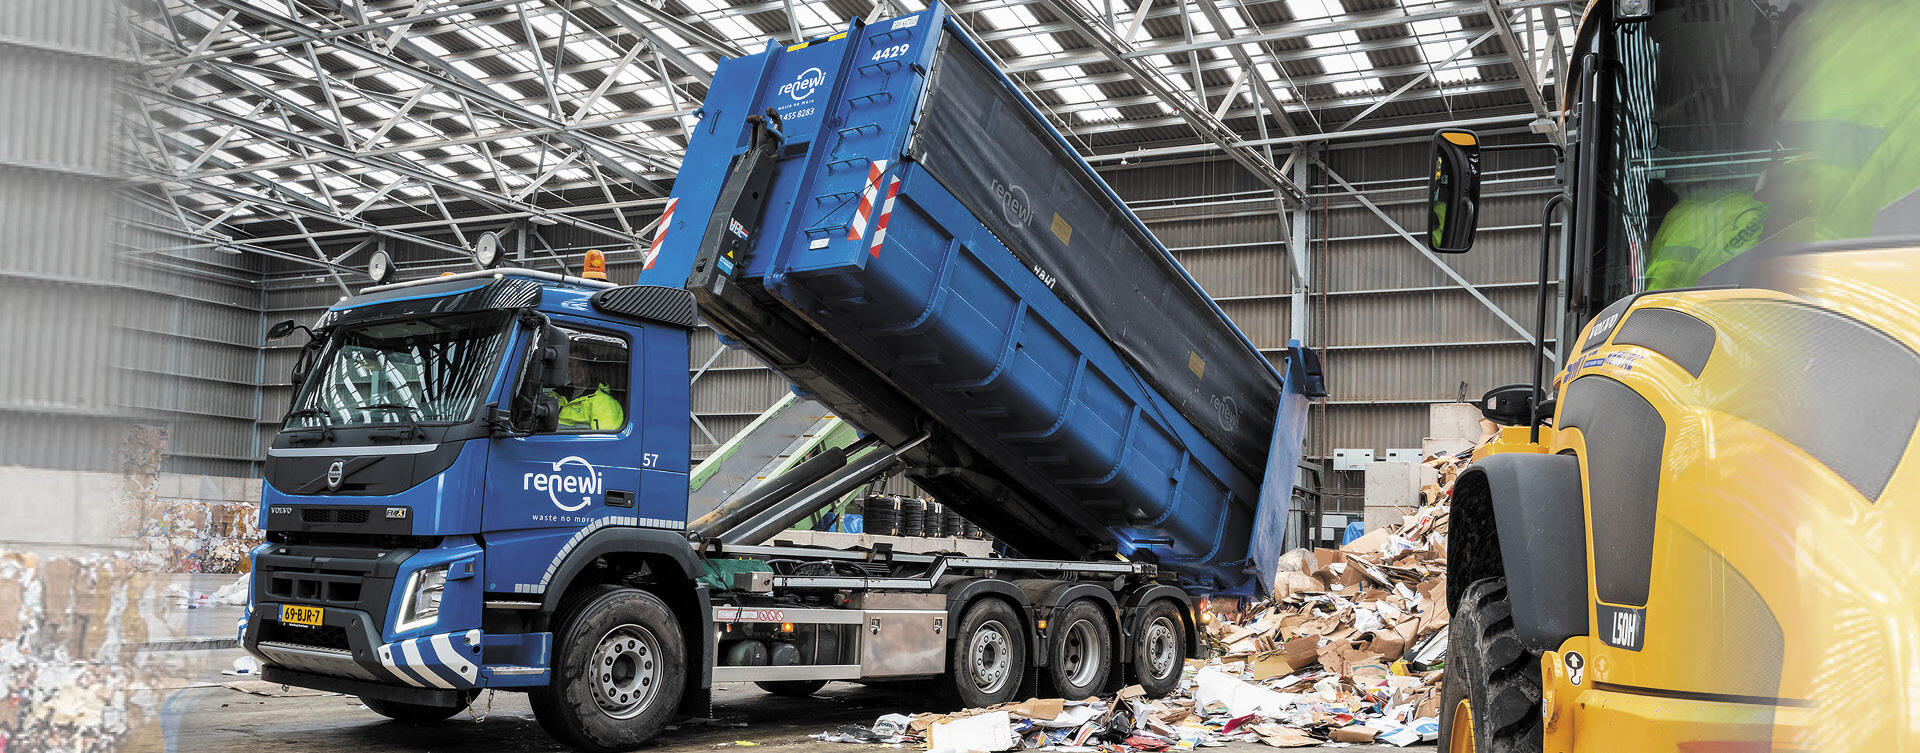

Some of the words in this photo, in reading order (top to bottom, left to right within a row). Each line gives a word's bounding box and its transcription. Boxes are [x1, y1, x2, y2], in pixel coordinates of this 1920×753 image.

[872, 43, 910, 61] 4429
[778, 71, 827, 96] renewi
[783, 111, 797, 120] 455
[797, 107, 815, 118] 8283
[991, 178, 1034, 227] renewi
[1588, 313, 1619, 340] VOLVO
[1210, 393, 1240, 428] renewi
[642, 453, 659, 467] 57
[523, 471, 603, 495] renewi
[270, 506, 293, 514] VOLVO
[532, 514, 557, 522] waste
[285, 607, 320, 623] 69-BJR-7
[1612, 611, 1636, 647] L50H
